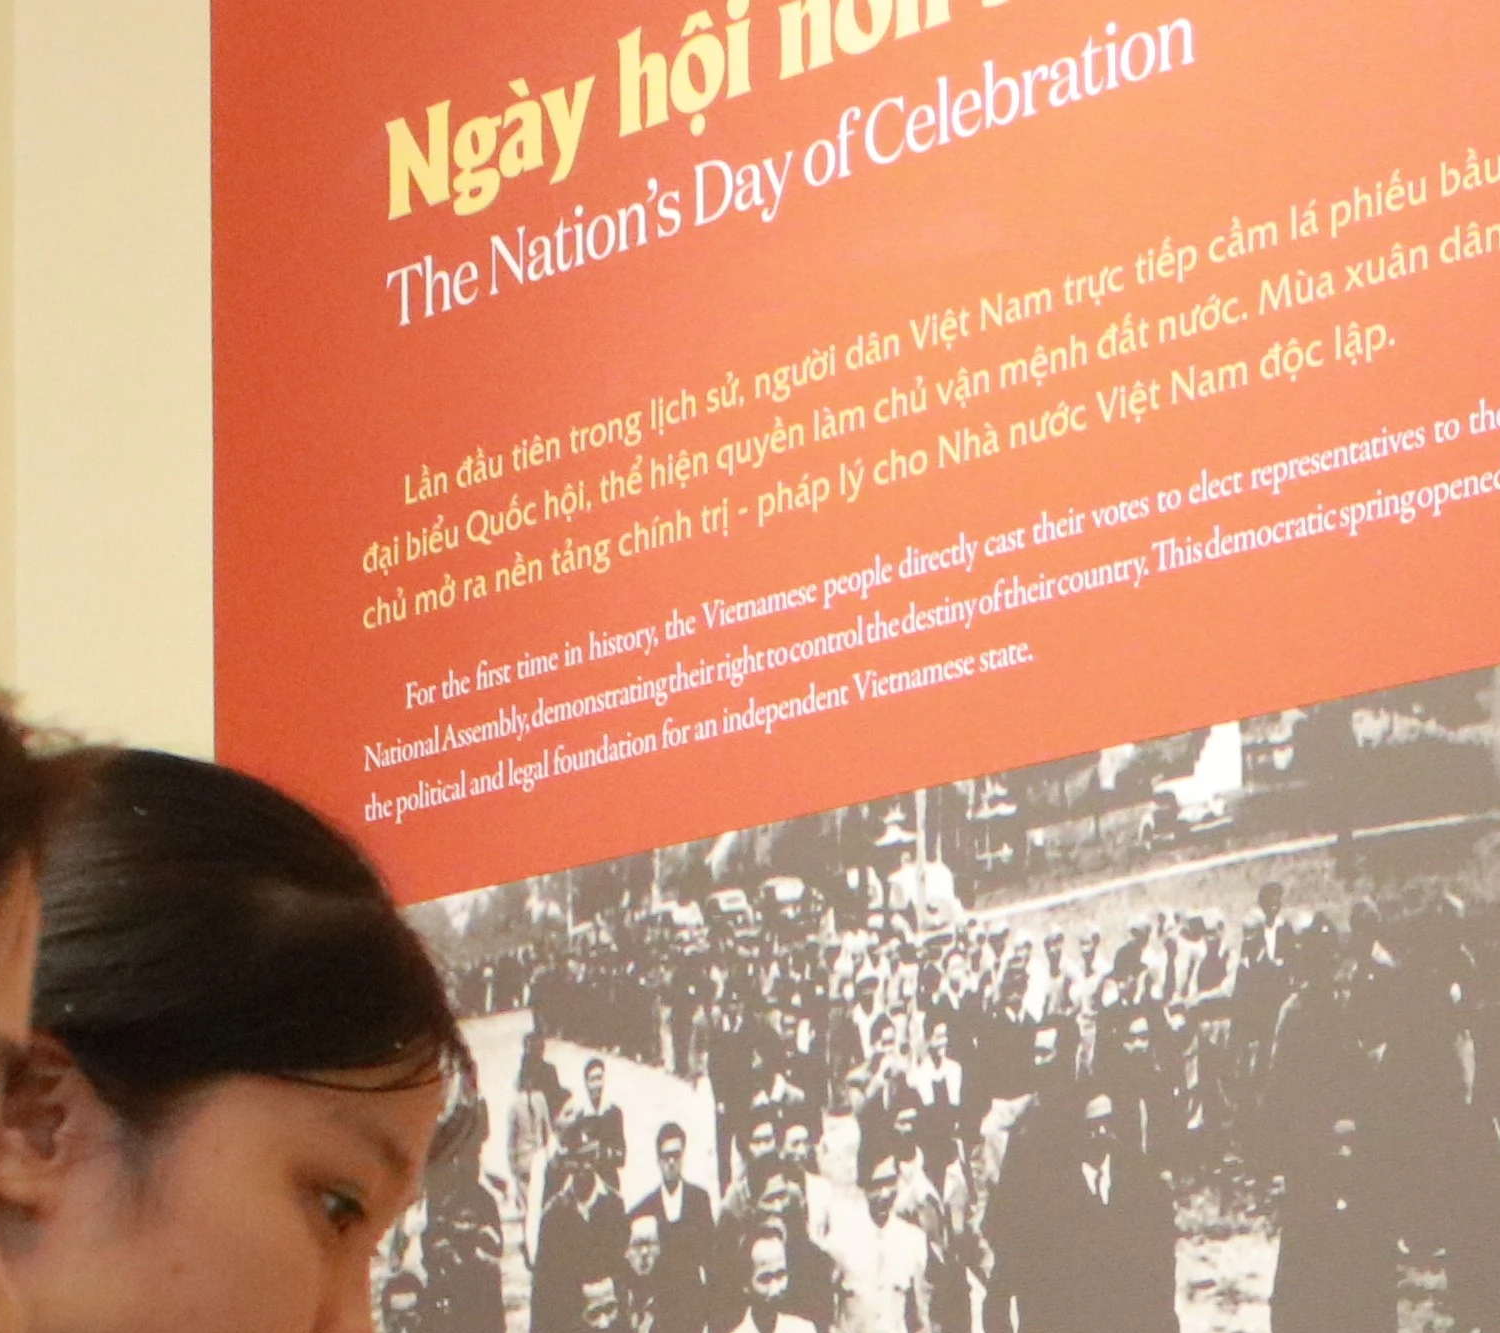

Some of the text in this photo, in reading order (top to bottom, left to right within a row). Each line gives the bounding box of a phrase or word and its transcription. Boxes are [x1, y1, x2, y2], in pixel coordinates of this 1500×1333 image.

[384, 75, 596, 220] Ngày
[617, 0, 752, 137] hội
[386, 254, 479, 326] The
[694, 150, 794, 226] Day
[803, 106, 862, 187] of
[864, 17, 1195, 165] Celebration
[362, 535, 400, 576] đại
[406, 514, 460, 562] biểu
[465, 493, 538, 546] Quốc
[544, 480, 593, 523] hội,
[599, 453, 643, 504] thể
[650, 449, 709, 490] hiện
[716, 415, 805, 476] quyền
[813, 405, 866, 442] làm
[873, 375, 928, 424] chủ
[935, 366, 991, 409] vận
[999, 334, 1088, 389] mệnh
[1096, 312, 1150, 360] đất
[1158, 293, 1248, 344] nước.
[1258, 269, 1336, 316] Mùa
[1344, 242, 1429, 292] xuân
[362, 321, 1396, 630] chủ mở ra nền tảng chính trị pháp lý cho Nhà nước Việt Nam độc lập.
[404, 464, 449, 505] Lần
[455, 447, 504, 489] đầu
[511, 434, 561, 472] tiên
[569, 410, 643, 454] trong
[650, 388, 697, 436] lịch
[706, 371, 745, 414] sử,
[754, 344, 836, 403] người
[845, 331, 901, 371] dân
[909, 307, 970, 351] Việt
[980, 287, 1053, 331] Nam
[1063, 265, 1125, 307] trực
[1134, 236, 1198, 285] tiếp
[1208, 216, 1279, 264] cầm
[1290, 199, 1319, 240] lá
[1330, 168, 1427, 239] phiếu
[364, 724, 441, 772] National
[440, 704, 531, 752] Assembly,
[531, 675, 669, 728] demonstrating
[667, 658, 716, 694] their
[716, 644, 766, 688] right
[765, 646, 789, 669] to
[787, 614, 865, 663] control
[865, 610, 901, 644] the
[900, 596, 978, 635] destiny
[977, 579, 1005, 615] of
[1003, 573, 1057, 610] their
[1056, 555, 1150, 597] country.
[1150, 536, 1204, 572] This
[1203, 503, 1337, 560] democratic
[1339, 489, 1417, 537] spring
[405, 680, 437, 710] For
[441, 669, 471, 700] the
[475, 659, 512, 691] first
[516, 652, 559, 680] time
[564, 641, 584, 668] in
[588, 625, 660, 661] history,
[664, 608, 697, 641] the
[701, 583, 818, 629] Vietnamese
[823, 554, 893, 610] people
[897, 531, 979, 579] directly
[983, 527, 1026, 558] cast
[1032, 507, 1086, 545] their
[1091, 496, 1151, 528] votes
[1156, 489, 1183, 513] to
[1188, 469, 1243, 505] elect
[1250, 426, 1426, 496] representatives
[1433, 418, 1461, 444] to
[364, 642, 1034, 825] the political and legal foundation for an independent Vietnamese state.
